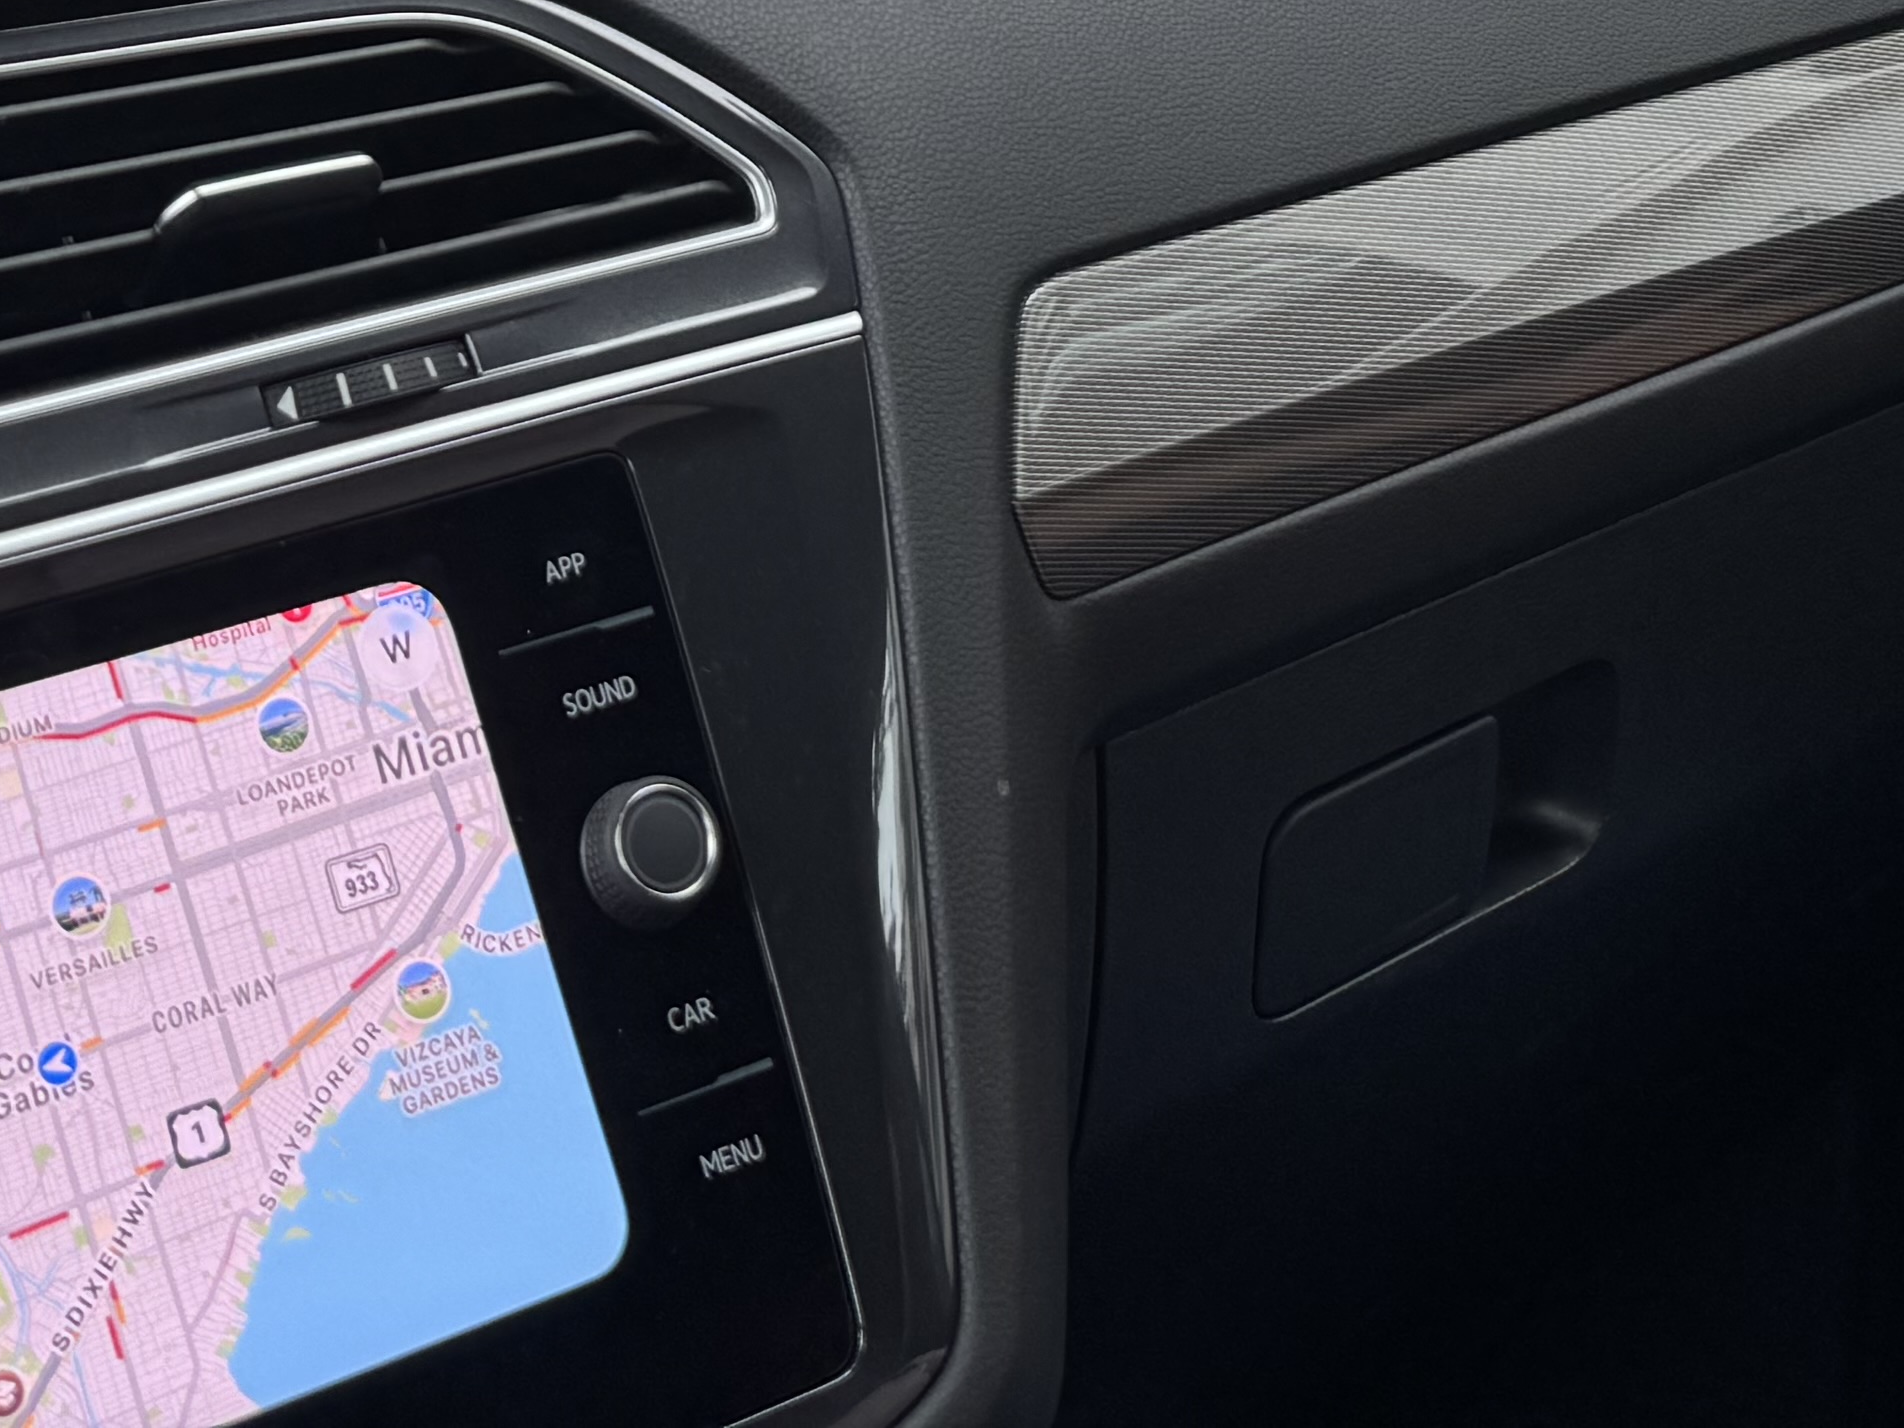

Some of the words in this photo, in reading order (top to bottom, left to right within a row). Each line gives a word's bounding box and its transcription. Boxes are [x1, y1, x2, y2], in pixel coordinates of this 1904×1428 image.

[545, 551, 586, 586] APP
[192, 616, 273, 652] Hospital
[380, 630, 411, 664] W
[562, 673, 638, 719] SOUND
[236, 754, 357, 806] LOANDEPOT
[277, 787, 331, 816] PARK
[345, 871, 380, 898] 933
[29, 935, 159, 990] VERSAILLES
[151, 992, 227, 1034] CORAL
[230, 973, 279, 1008] WAY
[667, 995, 716, 1033] CAR
[389, 1053, 479, 1095] MUSEUM
[484, 1043, 499, 1061] &
[394, 1025, 482, 1068] VIZCAYA
[402, 1066, 499, 1115] GARDENS
[191, 1121, 205, 1144] 1
[258, 1193, 277, 1212] S
[269, 1054, 355, 1188] BAYSHORE
[352, 1021, 382, 1058] DR
[699, 1133, 766, 1179] MENU
[52, 1332, 72, 1353] S
[65, 1251, 117, 1327] DIXIE
[112, 1181, 154, 1248] HWY
